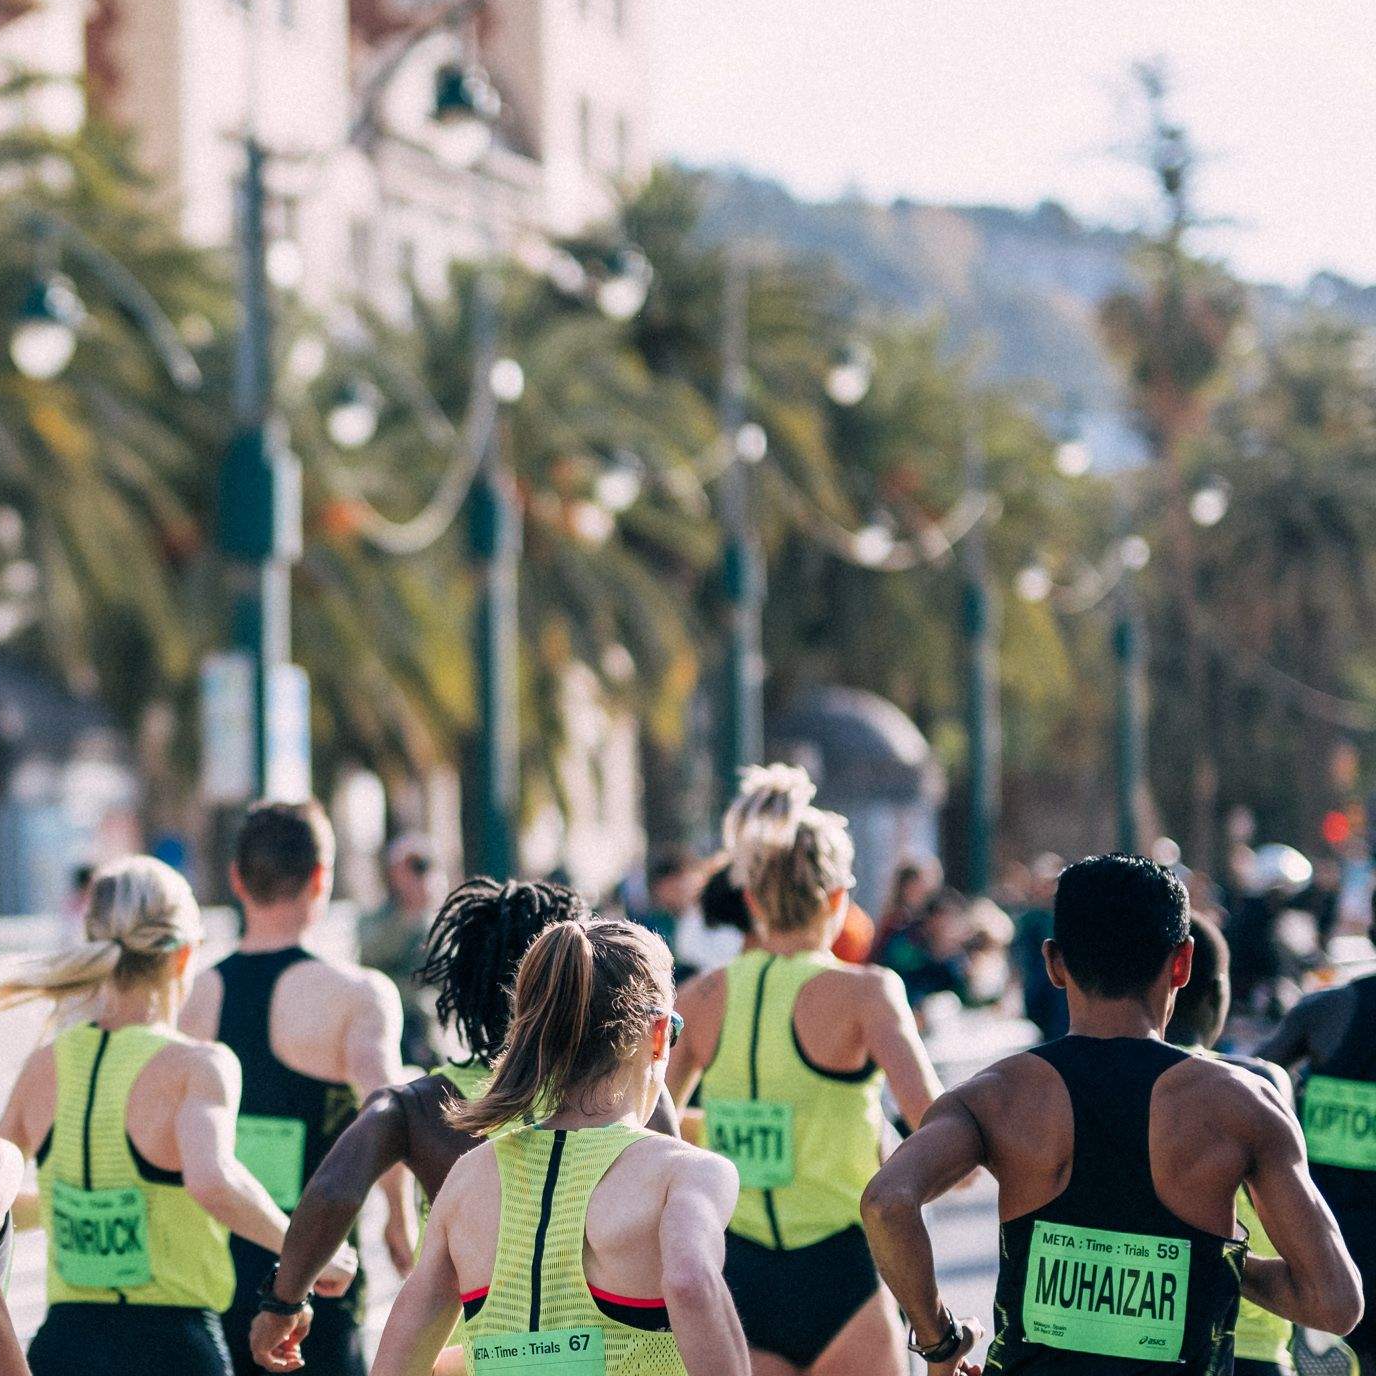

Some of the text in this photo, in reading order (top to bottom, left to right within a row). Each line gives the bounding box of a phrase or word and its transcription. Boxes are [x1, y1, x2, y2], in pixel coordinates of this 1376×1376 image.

[1042, 1232, 1075, 1248] META
[1085, 1238, 1113, 1253] Time
[1124, 1244, 1150, 1258] Trials
[1156, 1243, 1180, 1260] 59
[1035, 1256, 1177, 1321] MUHAIZAR
[495, 1345, 518, 1359] Time
[529, 1342, 561, 1355] Trials
[569, 1334, 590, 1352] 67
